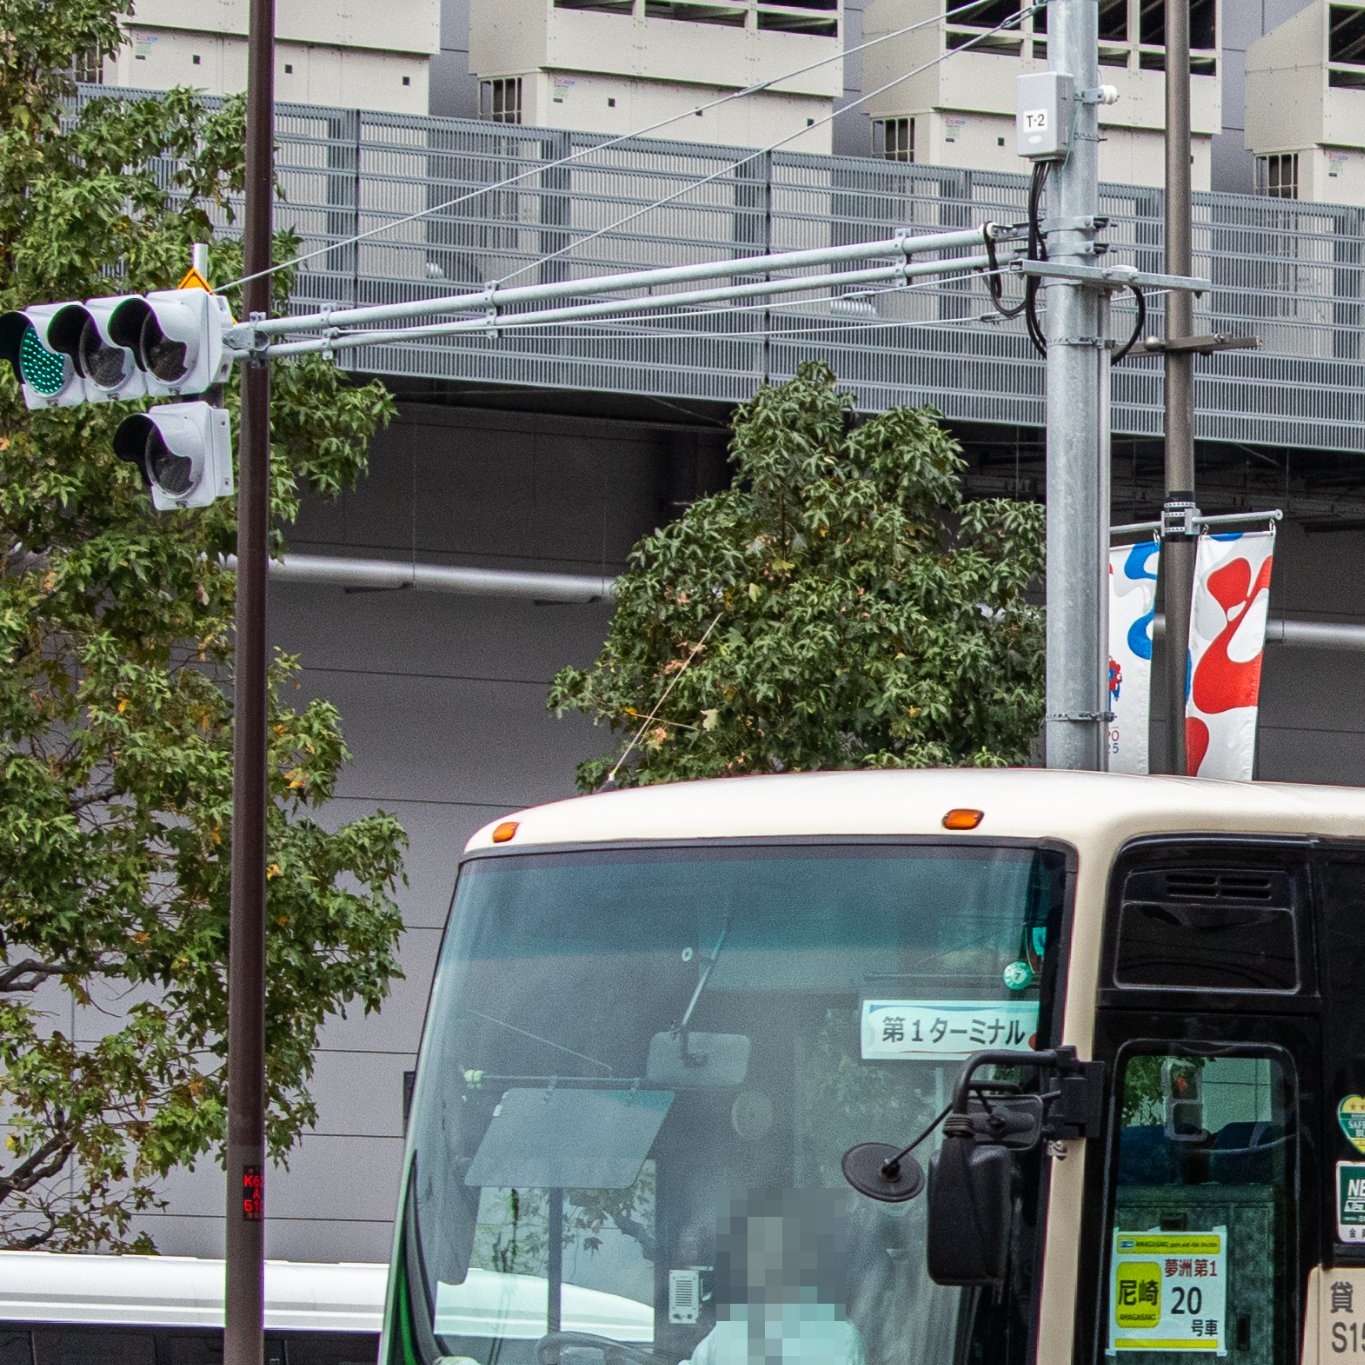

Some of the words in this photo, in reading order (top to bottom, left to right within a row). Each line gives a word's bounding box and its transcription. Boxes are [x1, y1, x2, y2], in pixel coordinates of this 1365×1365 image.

[881, 1015, 1026, 1046] 第1ターミナル
[1164, 1258, 1218, 1278] 夢洲第1
[1118, 1279, 1159, 1307] 尼崎
[1170, 1286, 1203, 1316] 20
[1191, 1319, 1219, 1337] 号車
